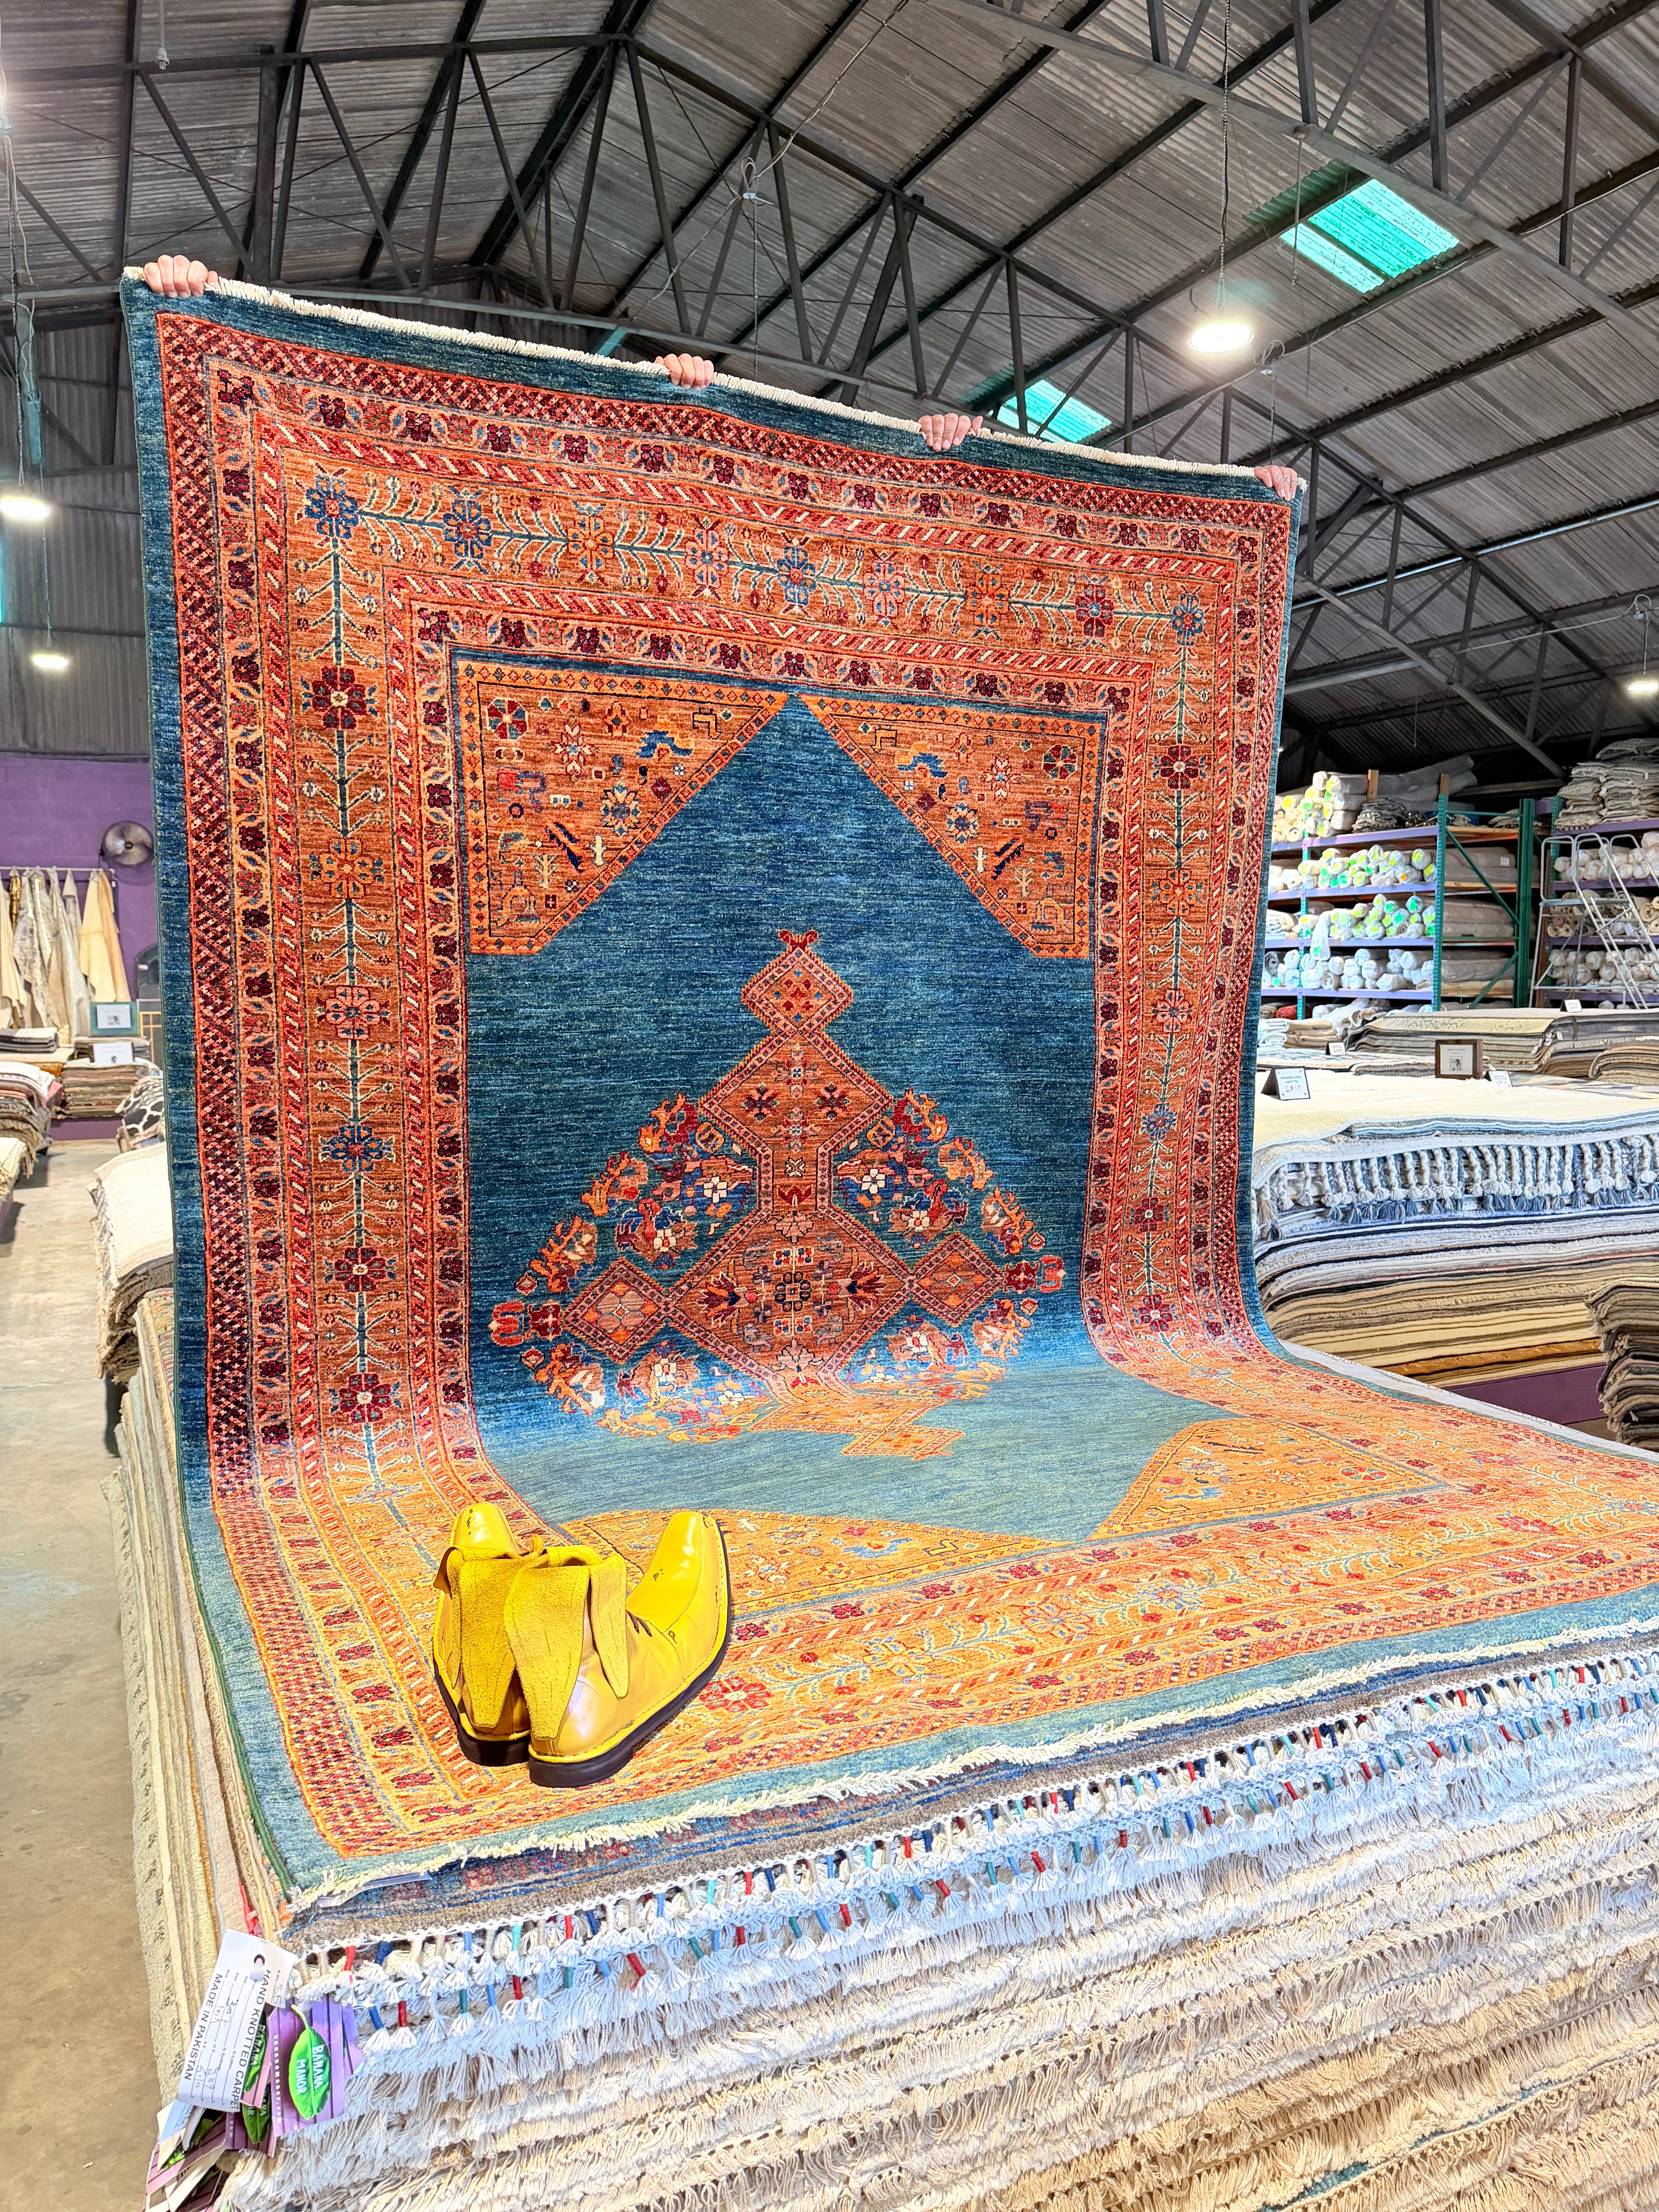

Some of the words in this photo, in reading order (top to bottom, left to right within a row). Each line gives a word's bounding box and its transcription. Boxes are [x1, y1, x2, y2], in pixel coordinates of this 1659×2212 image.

[206, 1973, 223, 2008] MADE
[256, 1969, 271, 2005] HAND
[201, 2010, 210, 2022] IN
[184, 2025, 206, 2080] PAKISTAN
[239, 2008, 261, 2067] KNOTTED
[296, 2059, 307, 2095] MANOR
[312, 2044, 324, 2089] BANANA
[230, 2070, 244, 2109] CARPET
